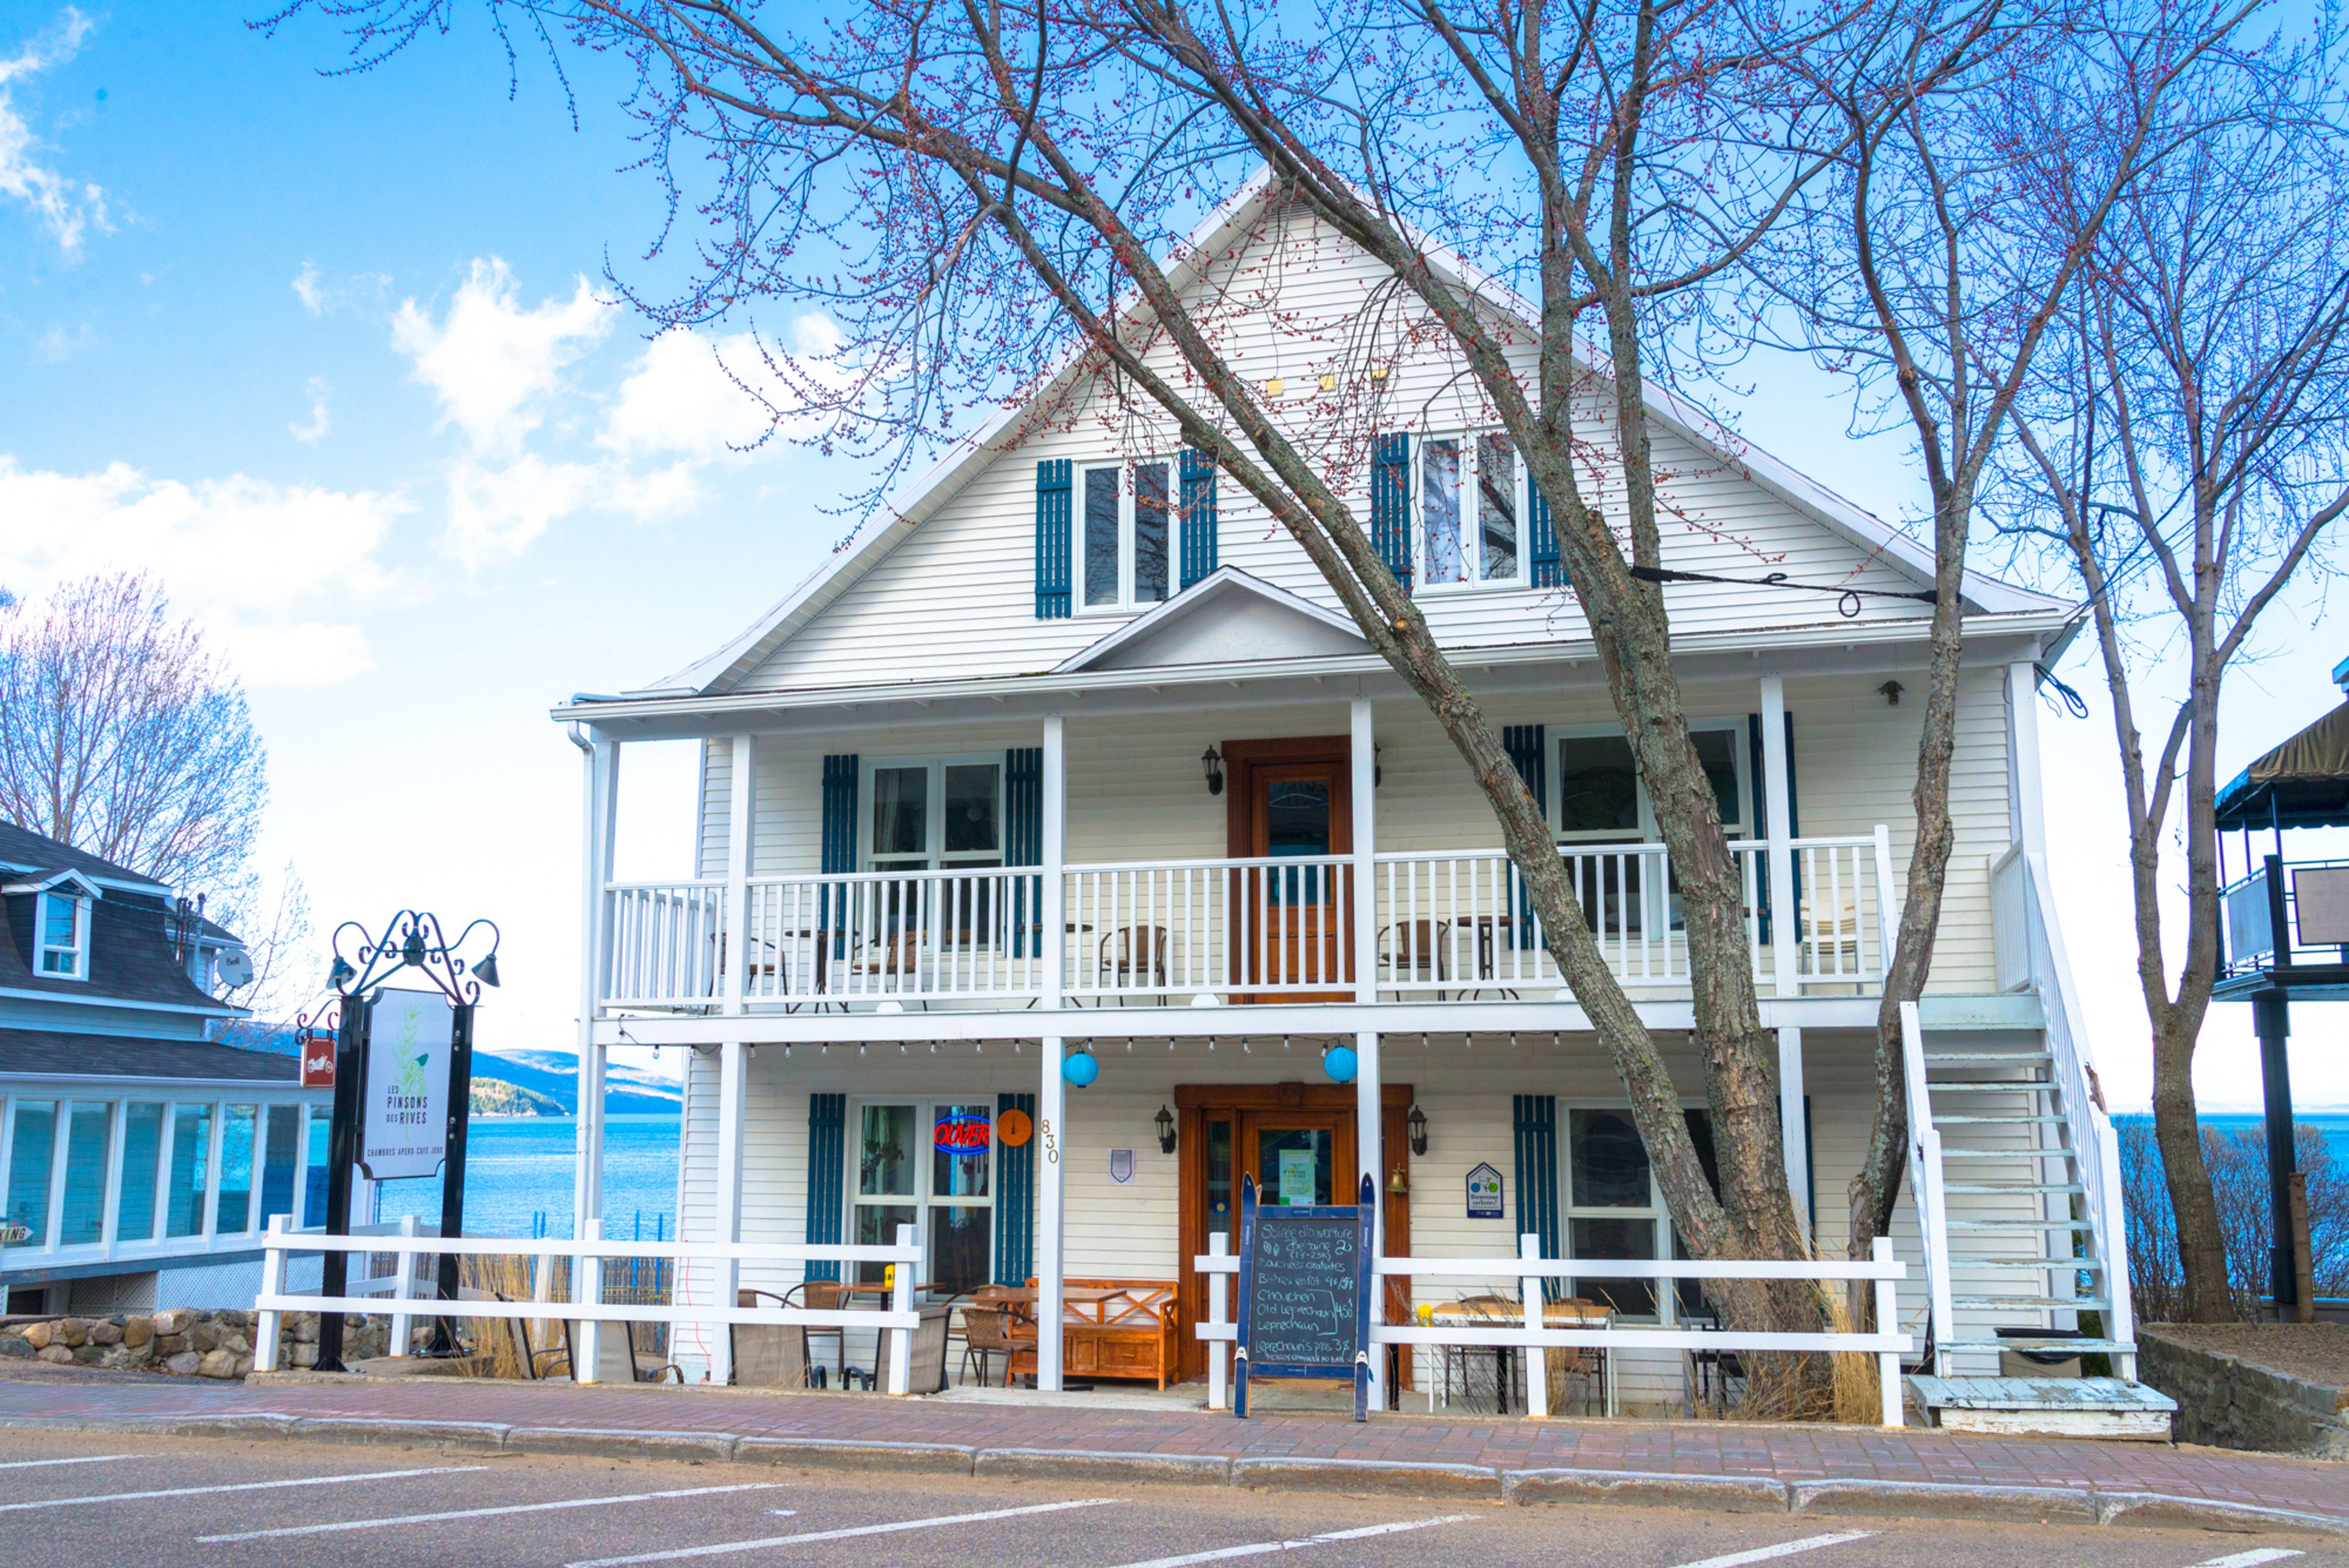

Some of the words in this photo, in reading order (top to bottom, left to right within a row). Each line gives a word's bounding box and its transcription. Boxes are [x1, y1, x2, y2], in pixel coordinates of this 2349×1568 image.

[226, 957, 240, 965] Bell
[388, 1085, 399, 1094] LES
[387, 1096, 428, 1109] PINSONS
[387, 1114, 398, 1123] DES
[399, 1112, 427, 1124] RIVES
[367, 1148, 395, 1157] CHAMBRES
[1261, 1224, 1297, 1239] Soirée
[1256, 1304, 1278, 1315] Old
[1258, 1319, 1319, 1334] Leprechaun
